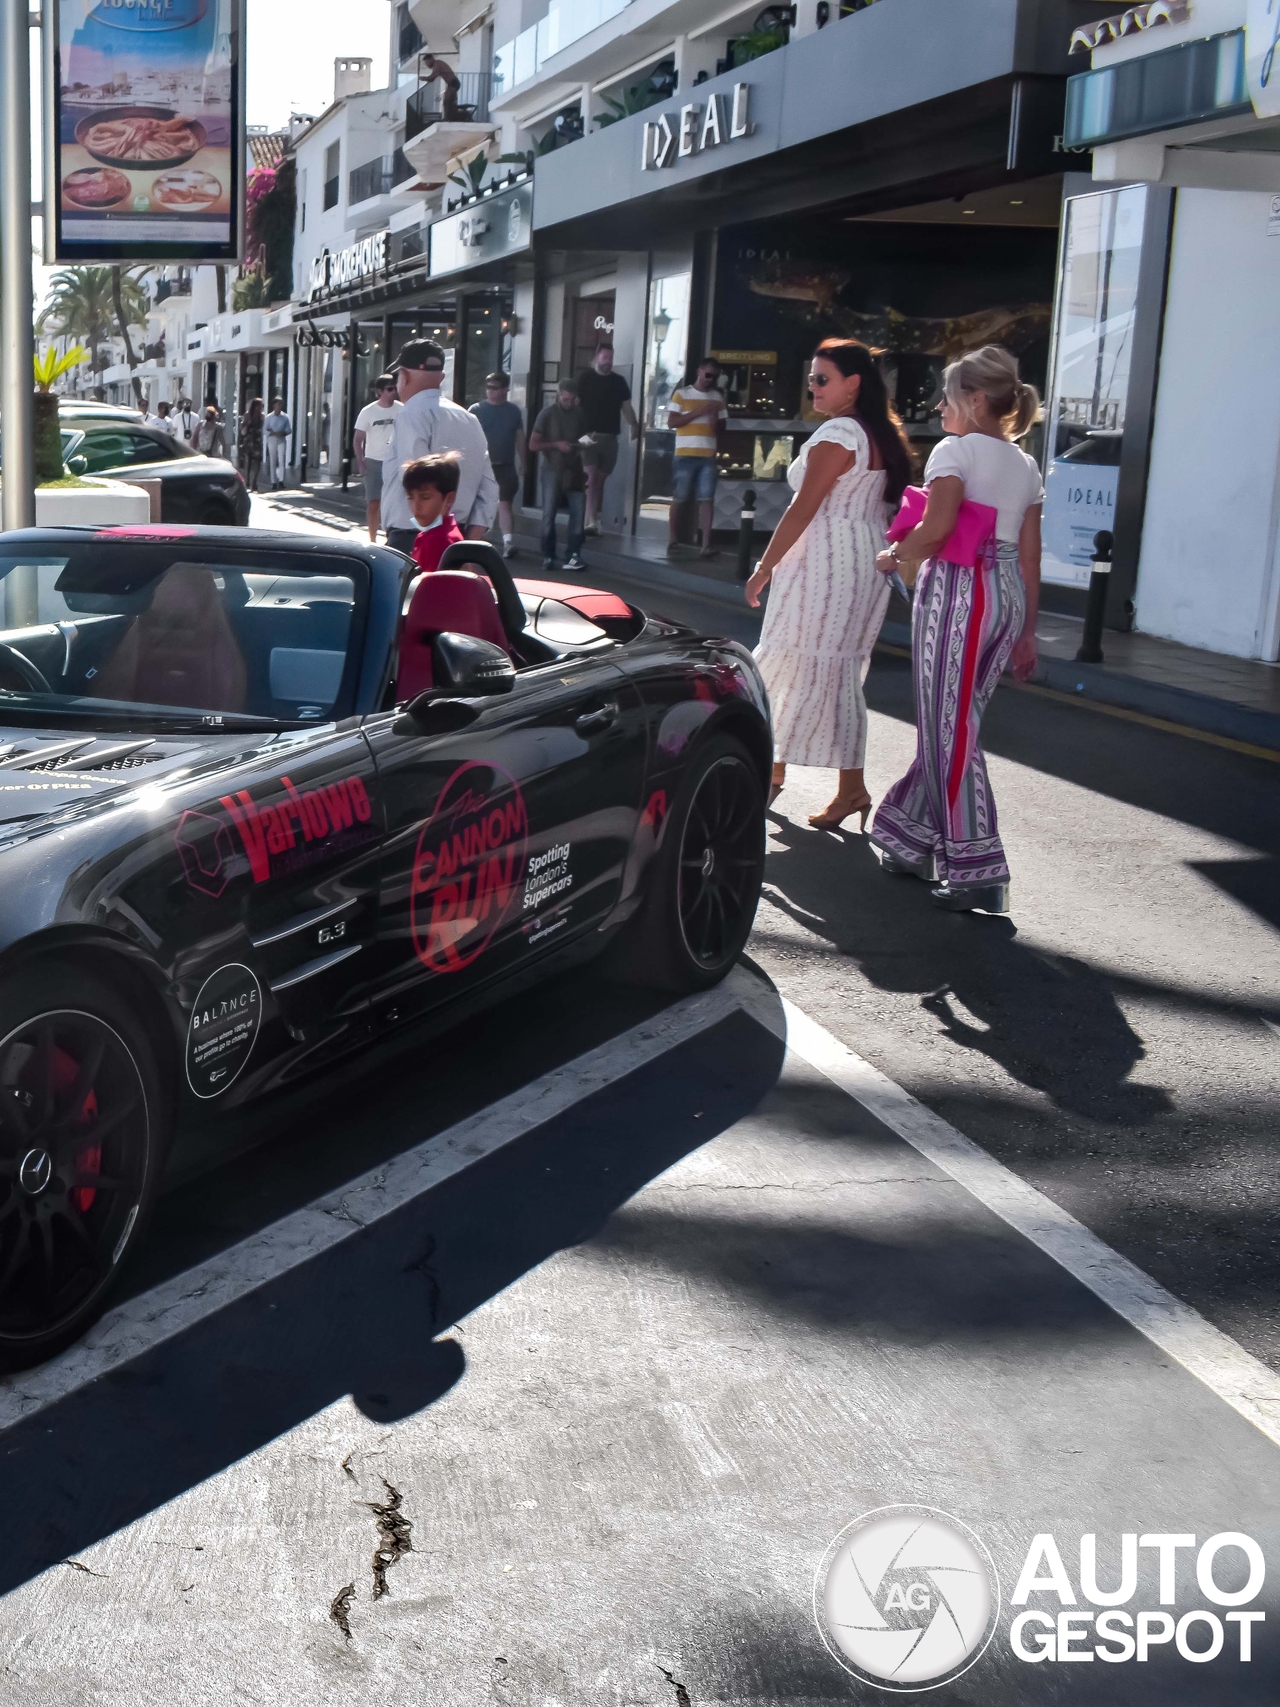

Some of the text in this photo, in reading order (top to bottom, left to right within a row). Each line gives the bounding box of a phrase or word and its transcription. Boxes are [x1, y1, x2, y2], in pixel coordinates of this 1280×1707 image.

[641, 83, 748, 171] IDEAL
[719, 352, 771, 361] BREITLING
[1068, 488, 1113, 507] IDEAL
[220, 776, 372, 884] Varlowe
[414, 801, 521, 893] CANNON
[528, 842, 570, 876] Spotting
[523, 874, 573, 909] Supercars
[525, 861, 568, 893] London's
[425, 843, 515, 966] RUN
[318, 921, 346, 944] 6.3
[193, 989, 257, 1029] BALANCE
